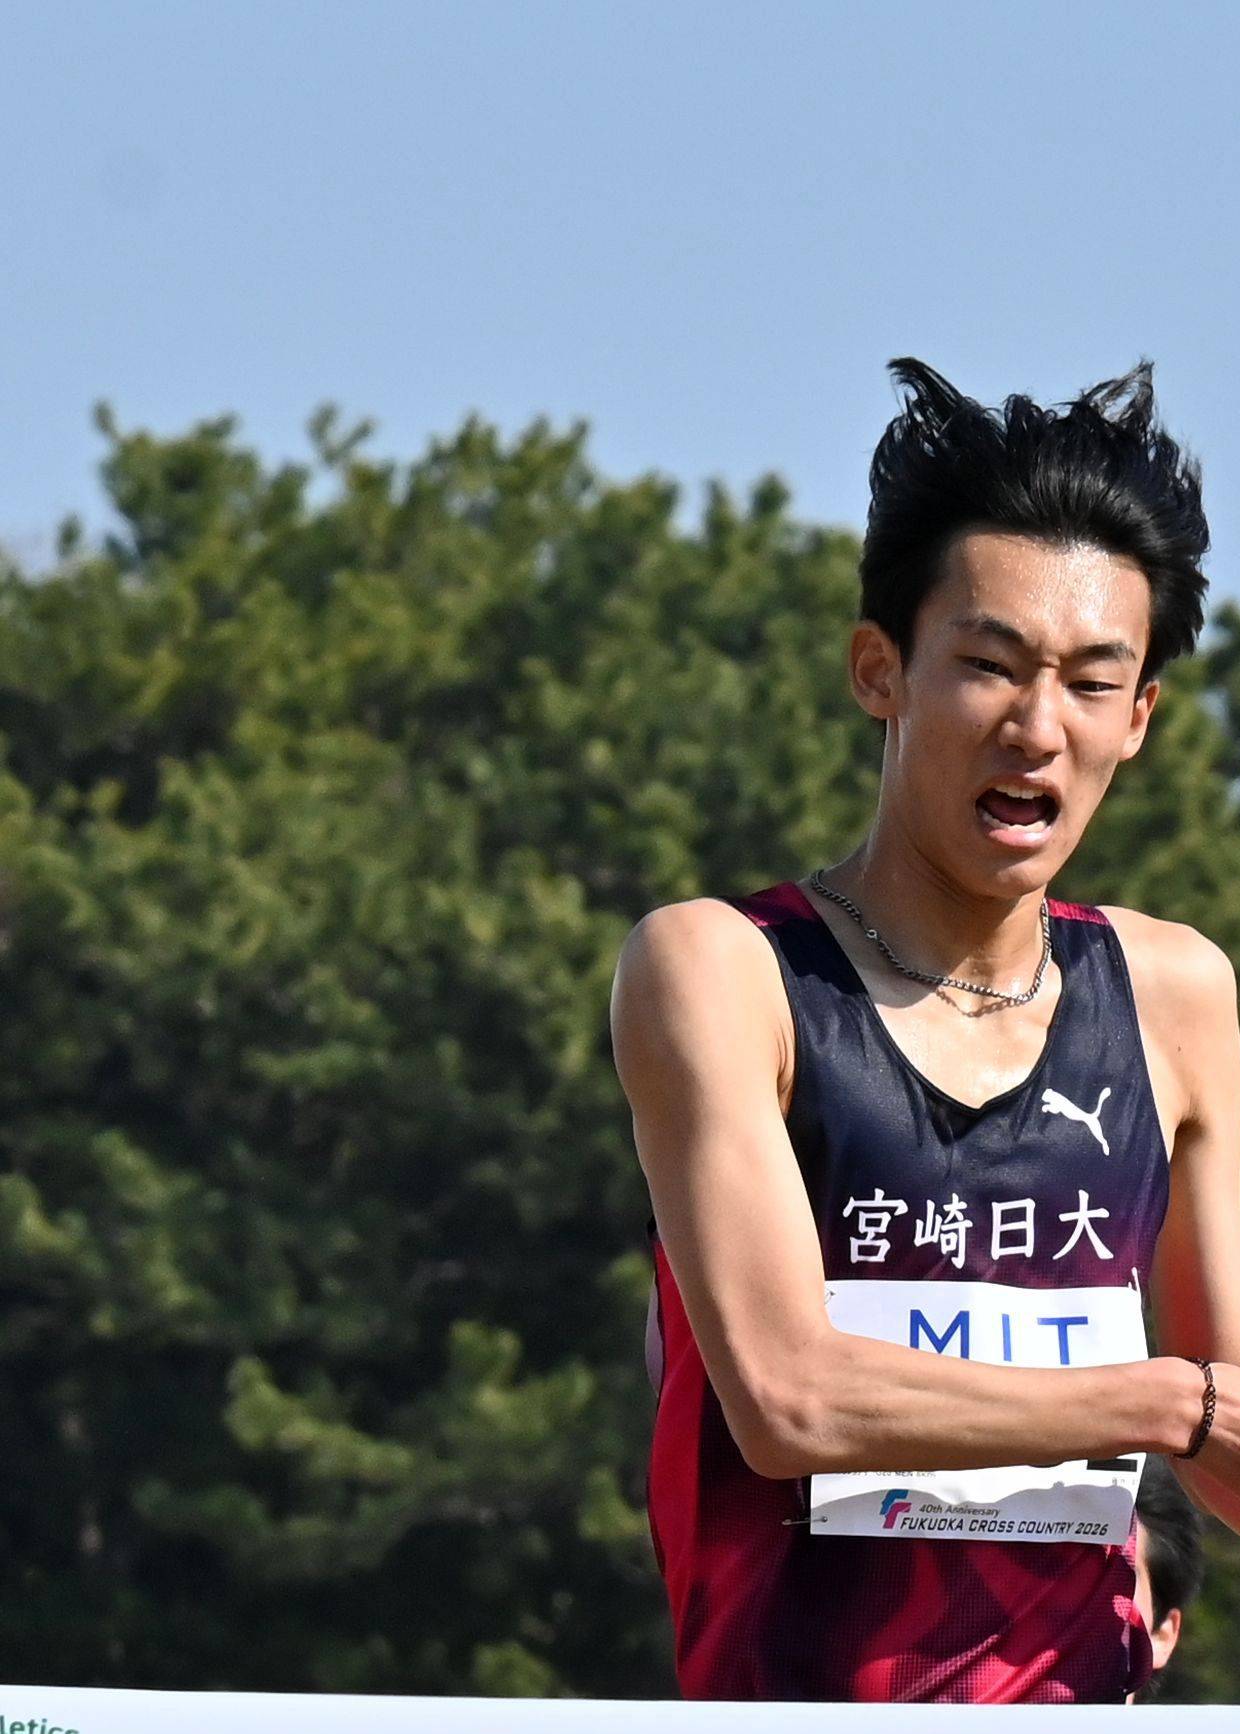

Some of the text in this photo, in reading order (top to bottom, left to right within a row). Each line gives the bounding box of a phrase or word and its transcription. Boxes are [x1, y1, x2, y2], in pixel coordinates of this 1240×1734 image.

[843, 1187, 1114, 1269] 宮崎日大
[909, 1309, 1089, 1366] MIT
[900, 1516, 1110, 1536] FUKUOKA CROSS COUNTRY 2026
[919, 1503, 1000, 1517] 40th Anniversary
